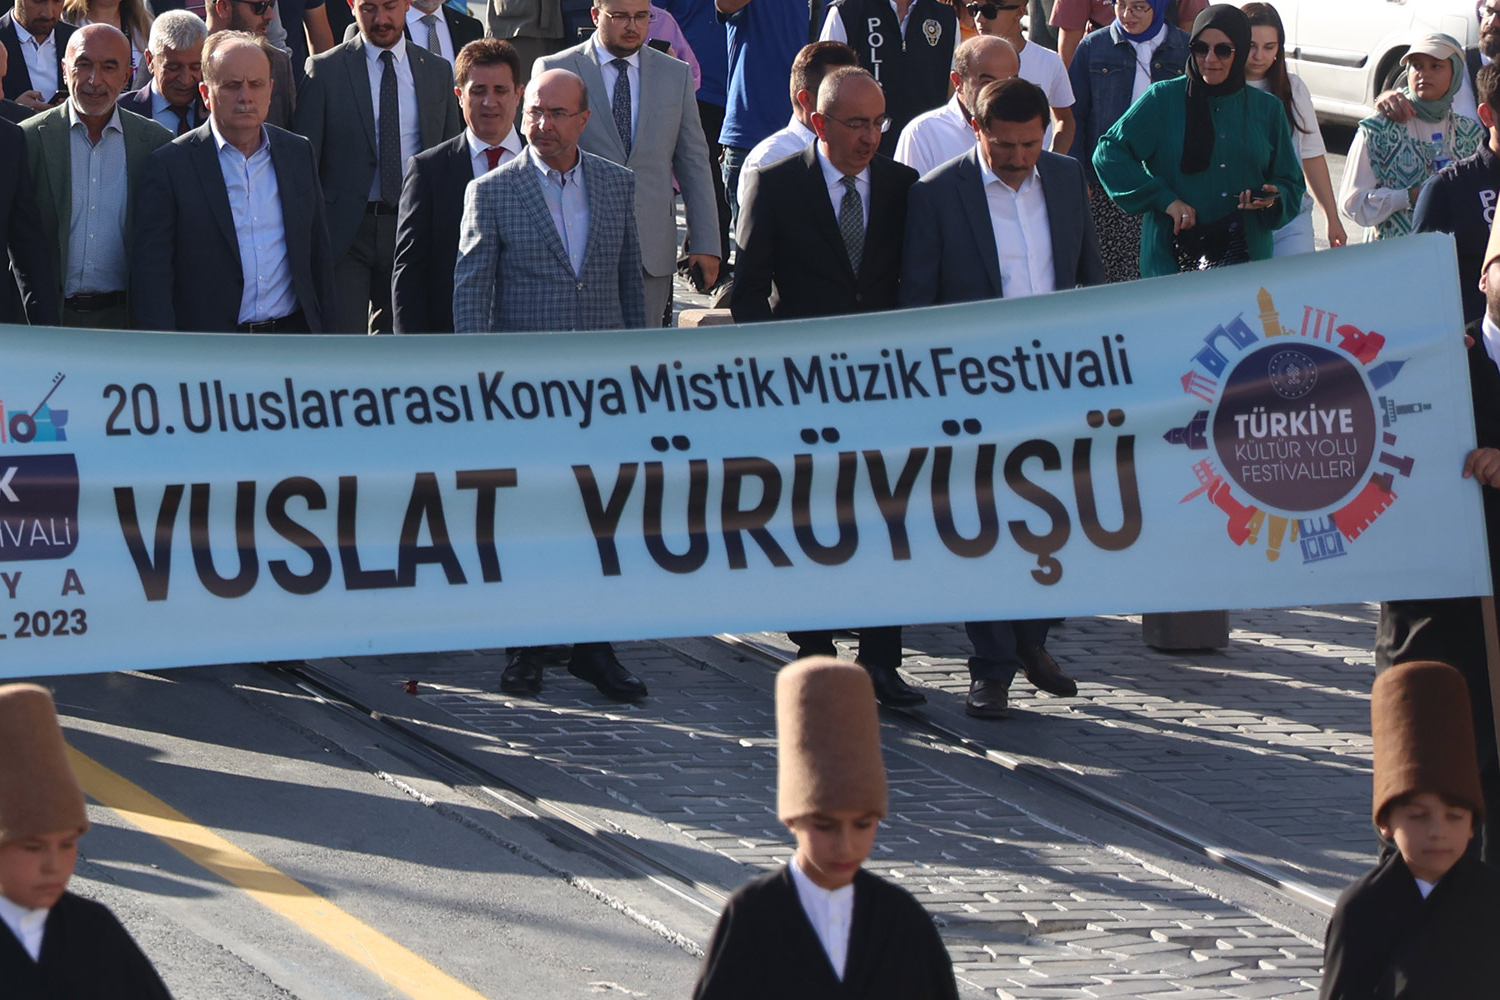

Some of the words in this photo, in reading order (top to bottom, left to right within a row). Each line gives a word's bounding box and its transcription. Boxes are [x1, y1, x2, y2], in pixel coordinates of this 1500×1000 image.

[103, 382, 175, 437] 20.
[180, 377, 474, 435] Uluslararası
[477, 371, 628, 429] Konya
[629, 357, 785, 414] Mistik
[783, 348, 931, 405] Müzik
[930, 334, 1134, 397] Festivali
[1234, 403, 1354, 439] TÜRKİYE
[1235, 437, 1301, 461] KÜLTÜR
[1306, 438, 1358, 457] YOLU
[1241, 456, 1356, 483] FESTİVALLERİ
[114, 467, 518, 602] VUSLAT
[571, 408, 1143, 587] YÜRÜYÜŞÜ
[14, 608, 88, 639] 2023
